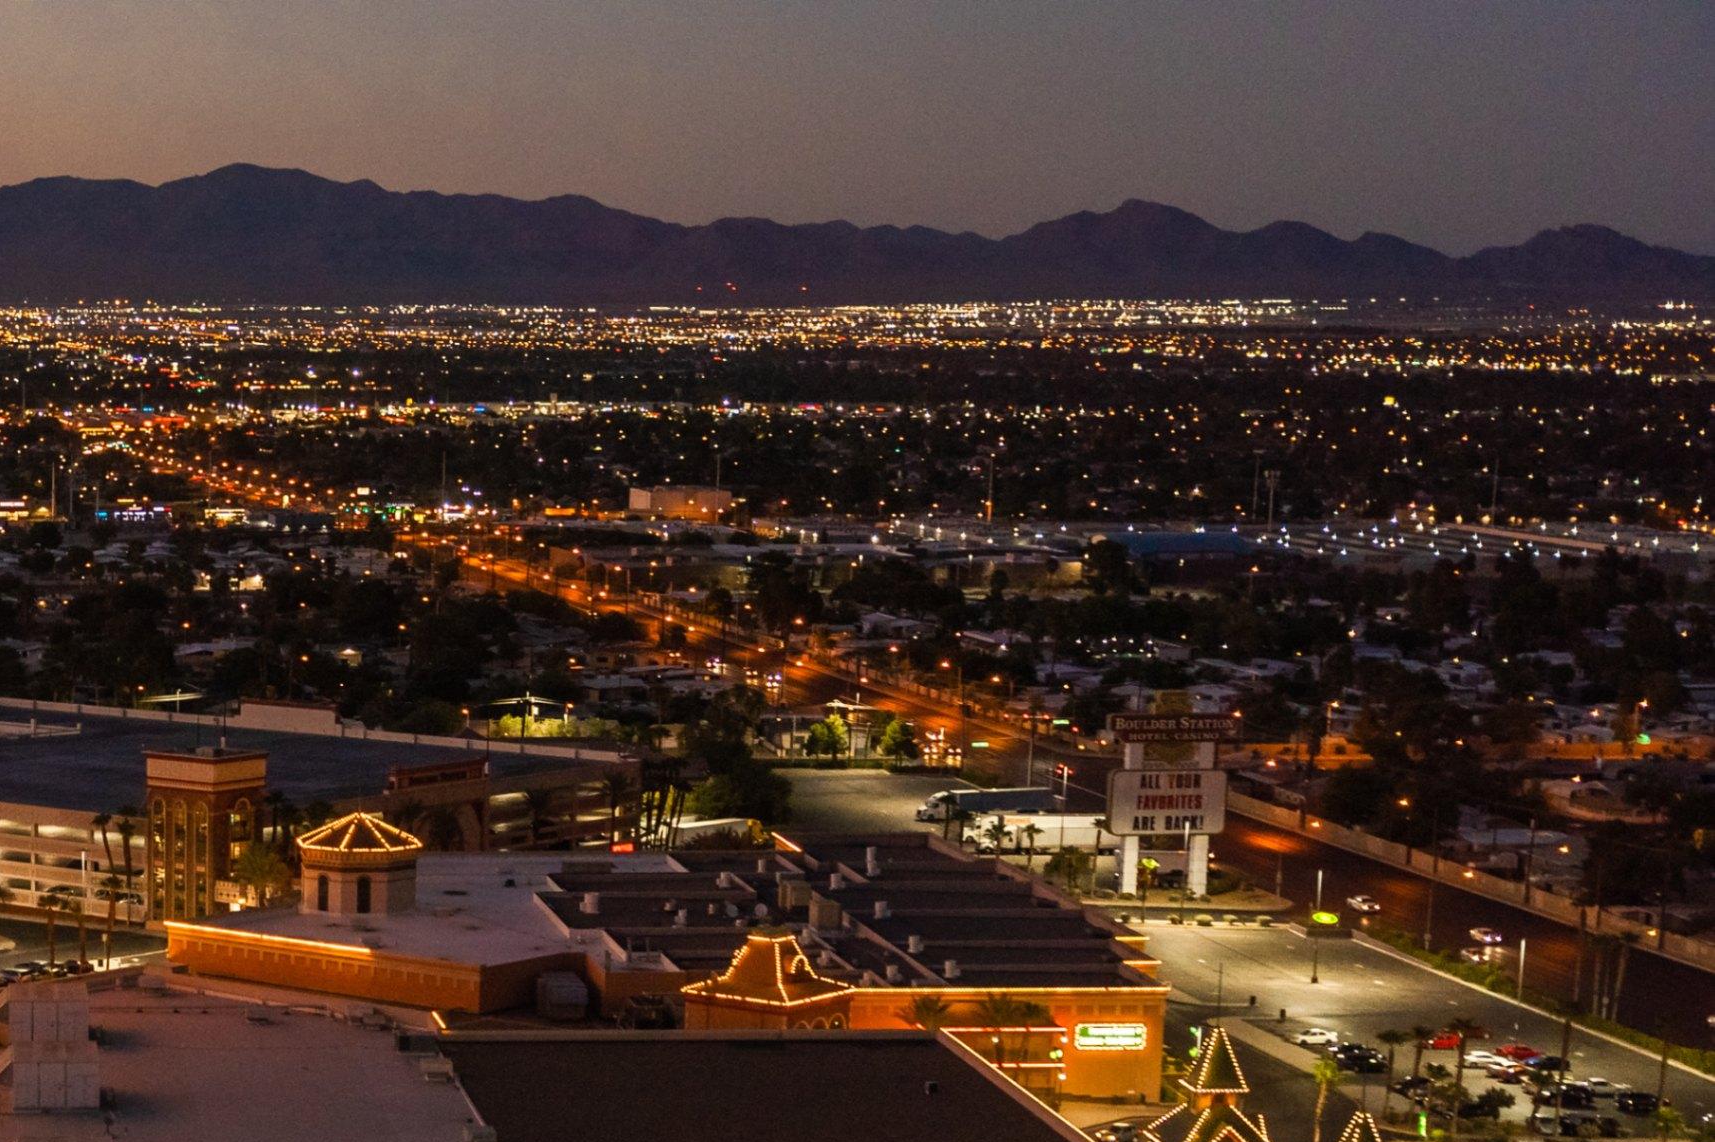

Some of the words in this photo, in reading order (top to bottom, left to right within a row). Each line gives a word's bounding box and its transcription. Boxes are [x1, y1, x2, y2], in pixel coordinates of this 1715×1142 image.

[1115, 717, 1176, 730] BOULDER
[1179, 716, 1235, 730] STATION
[1129, 732, 1171, 741] HOTEL
[1175, 732, 1219, 740] CASINO
[1140, 773, 1160, 789] ALL
[1169, 773, 1202, 789] YOUR
[1137, 794, 1203, 810] FAVORITES
[1132, 815, 1156, 831] ARE
